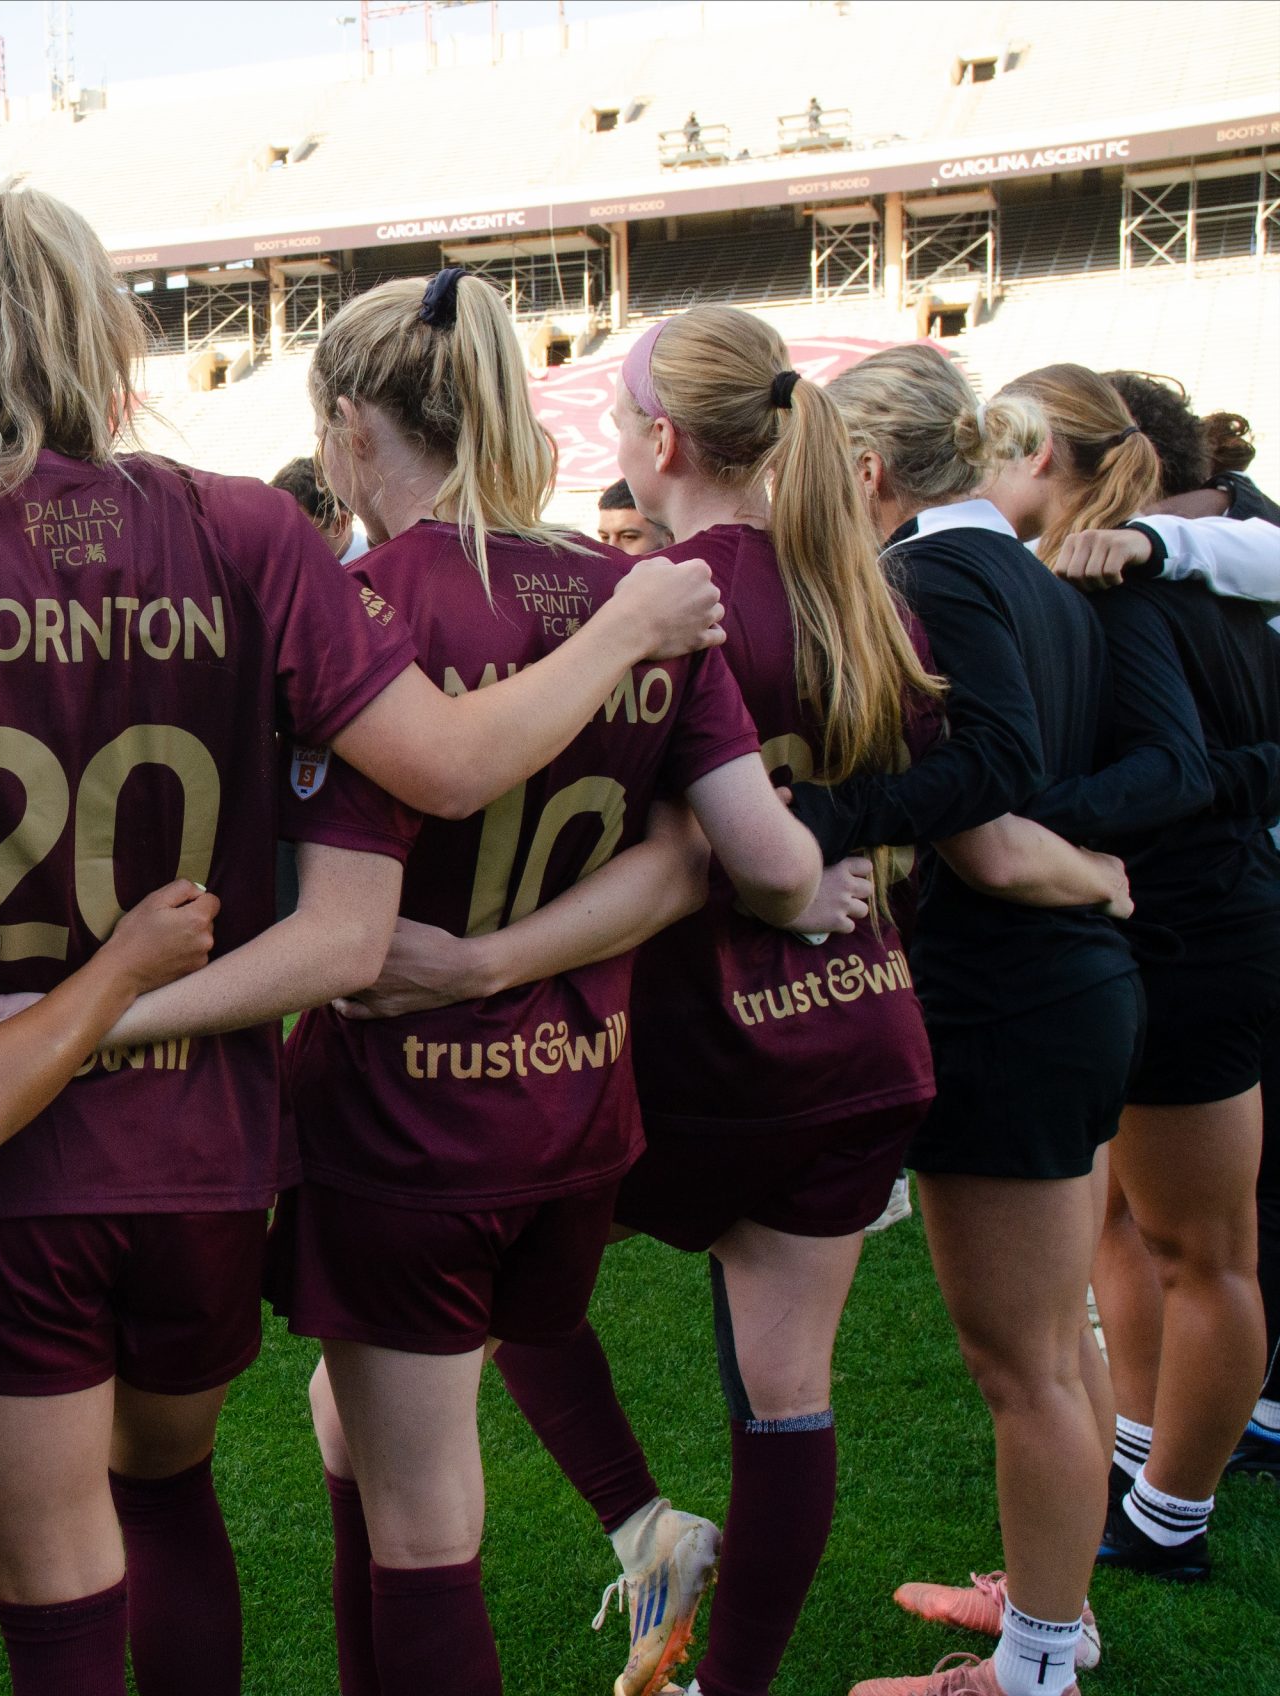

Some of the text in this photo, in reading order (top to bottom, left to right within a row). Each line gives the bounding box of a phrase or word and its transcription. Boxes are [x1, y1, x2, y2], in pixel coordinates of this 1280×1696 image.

[939, 140, 1130, 179] CAROLINA ASCENT FC
[830, 177, 869, 192] RODEO
[628, 200, 665, 213] RODEO
[376, 211, 525, 240] CAROLINA ASCENT FC
[288, 236, 320, 248] RODEO
[25, 498, 119, 523] DALLAS
[24, 518, 124, 547] TRINITY
[51, 546, 84, 569] FC
[513, 573, 589, 593] DALLAS
[516, 593, 593, 615] TRINITY
[543, 615, 565, 637] FC
[462, 774, 628, 938] 10
